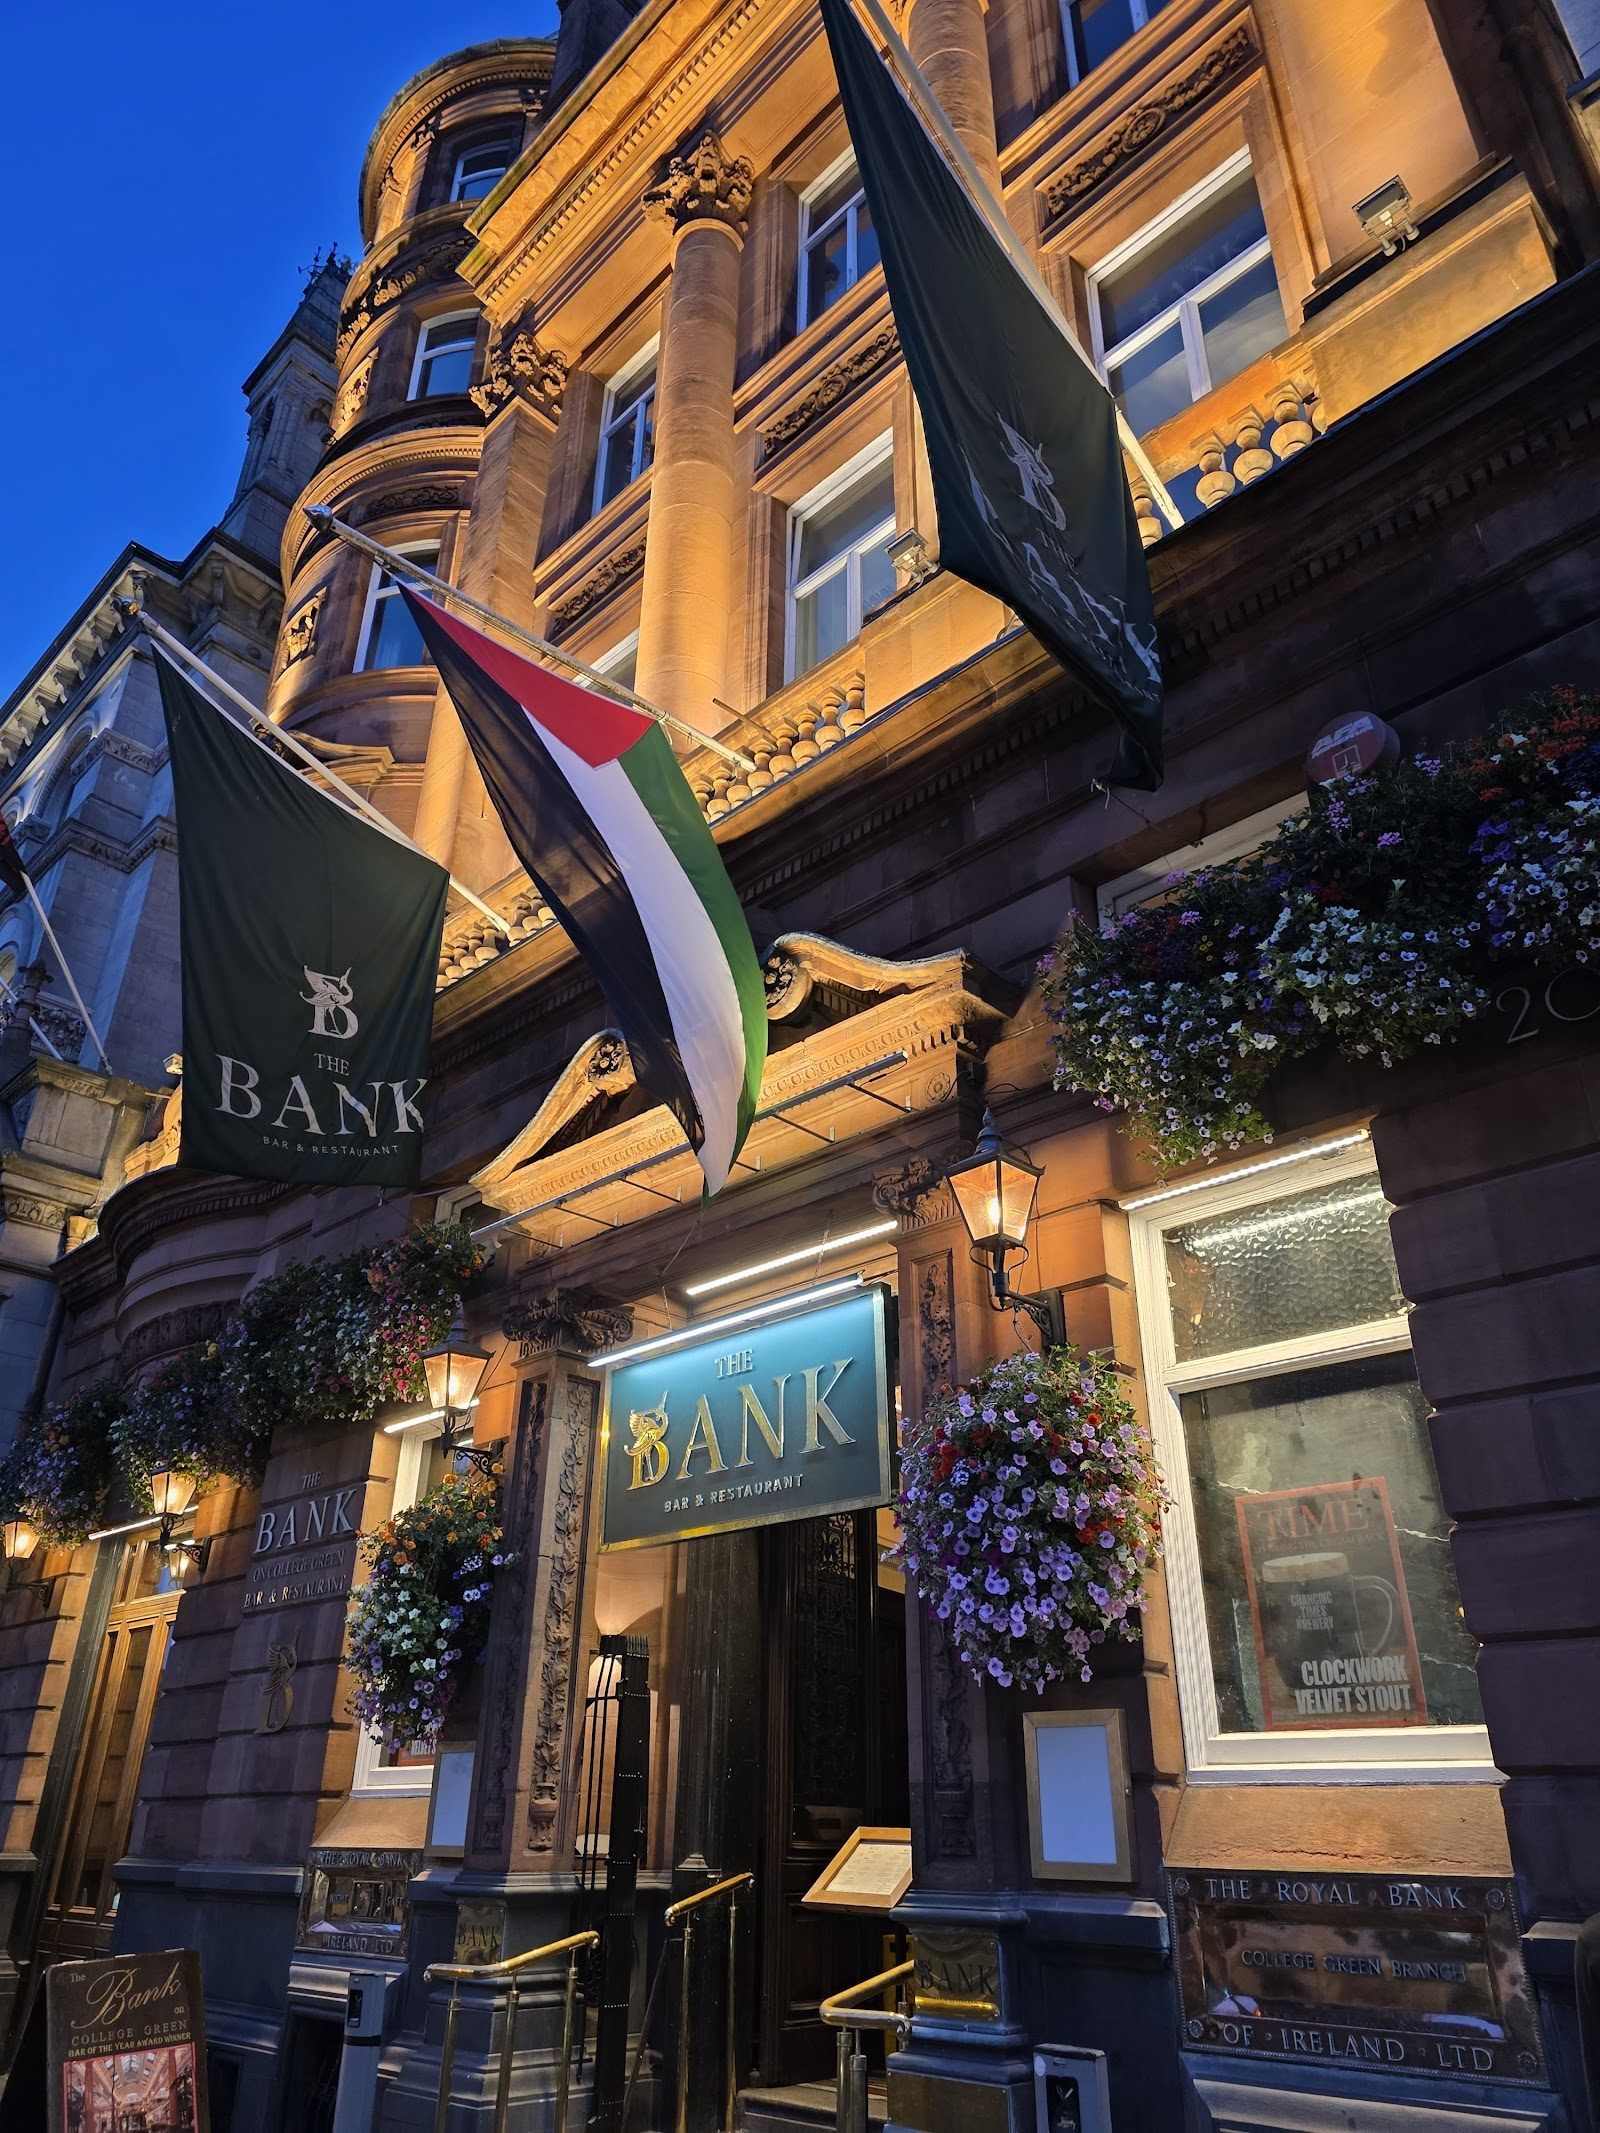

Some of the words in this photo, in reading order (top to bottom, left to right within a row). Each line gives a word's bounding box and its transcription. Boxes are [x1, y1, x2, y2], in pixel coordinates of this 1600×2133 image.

[314, 1053, 350, 1077] THE
[214, 1053, 428, 1138] BANK
[263, 1136, 289, 1150] BAR
[296, 1143, 304, 1153] &
[312, 1145, 399, 1157] RESTAURANT
[714, 1350, 754, 1379] THE
[624, 1357, 856, 1491] BANK
[302, 1471, 322, 1490] THE
[664, 1497, 689, 1513] BAR
[695, 1494, 704, 1507] &
[710, 1473, 804, 1504] RESTAURANT
[253, 1489, 357, 1554] BANK
[1257, 1497, 1370, 1541] TIME
[267, 1557, 310, 1579] COLLEGE
[311, 1550, 345, 1569] GREEN
[244, 1591, 263, 1608] BAR
[269, 1588, 277, 1603] &
[281, 1574, 347, 1601] RESTAURANT
[1296, 1616, 1334, 1631] BREWERY
[1300, 1605, 1327, 1618] TIMES
[1302, 1656, 1408, 1686] CLOCKWORK
[1294, 1688, 1352, 1715] VELVET
[1356, 1684, 1411, 1713] STOUT
[319, 1851, 336, 1865] THE
[379, 1852, 404, 1867] BANK
[1205, 1878, 1252, 1900] THE
[1277, 1881, 1360, 1906] ROYAL
[1388, 1884, 1468, 1909] BANK
[327, 1935, 368, 1951] IRELAND
[375, 1939, 393, 1954] LTD
[457, 1923, 500, 1948] BANK
[69, 1973, 86, 1983] The
[916, 1957, 996, 1995] BANK
[1241, 1949, 1315, 1971] COLLEGE
[1324, 1955, 1381, 1976] GREEN
[1391, 1960, 1467, 1983] BRANCH
[70, 1961, 182, 2029] Bank
[174, 2005, 184, 2014] on
[68, 2047, 85, 2057] BAR
[87, 2046, 96, 2055] OF
[98, 2043, 113, 2053] THE
[115, 2039, 135, 2050] YEAR
[136, 2036, 163, 2047] AWARD
[164, 2031, 192, 2043] WINNER
[71, 2028, 134, 2046] COLLEGE
[144, 2019, 187, 2035] GREEN
[1222, 2022, 1254, 2047] OF
[1280, 2028, 1405, 2062] IRELAND
[1436, 2043, 1494, 2072] LTD
